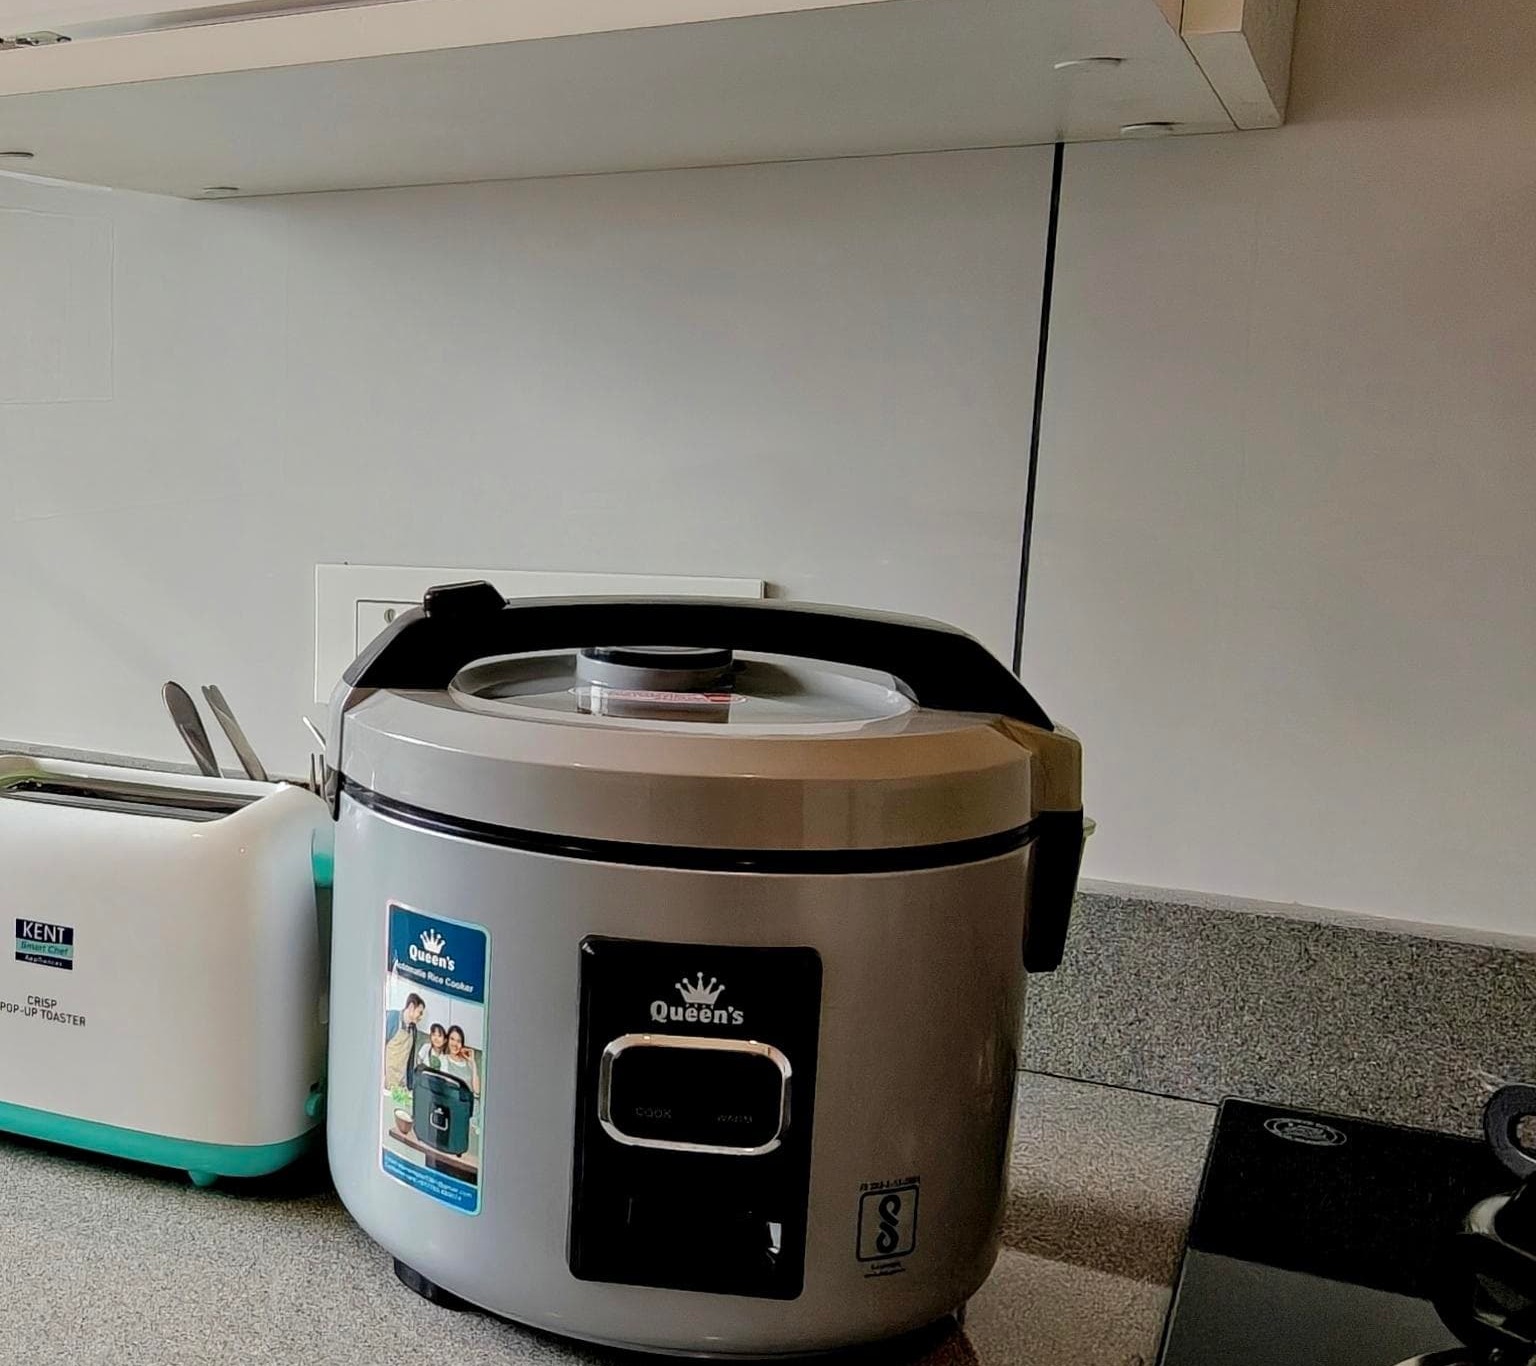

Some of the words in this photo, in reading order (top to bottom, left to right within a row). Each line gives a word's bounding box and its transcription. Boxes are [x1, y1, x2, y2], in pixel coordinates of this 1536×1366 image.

[23, 920, 65, 943] KENT
[408, 944, 456, 971] Queen's
[427, 971, 444, 985] Rice
[445, 977, 474, 993] Cooker
[0, 1001, 38, 1017] POP-UP
[40, 1009, 86, 1027] TOASTER
[27, 995, 57, 1009] CRISP
[650, 1000, 744, 1025] Queen's
